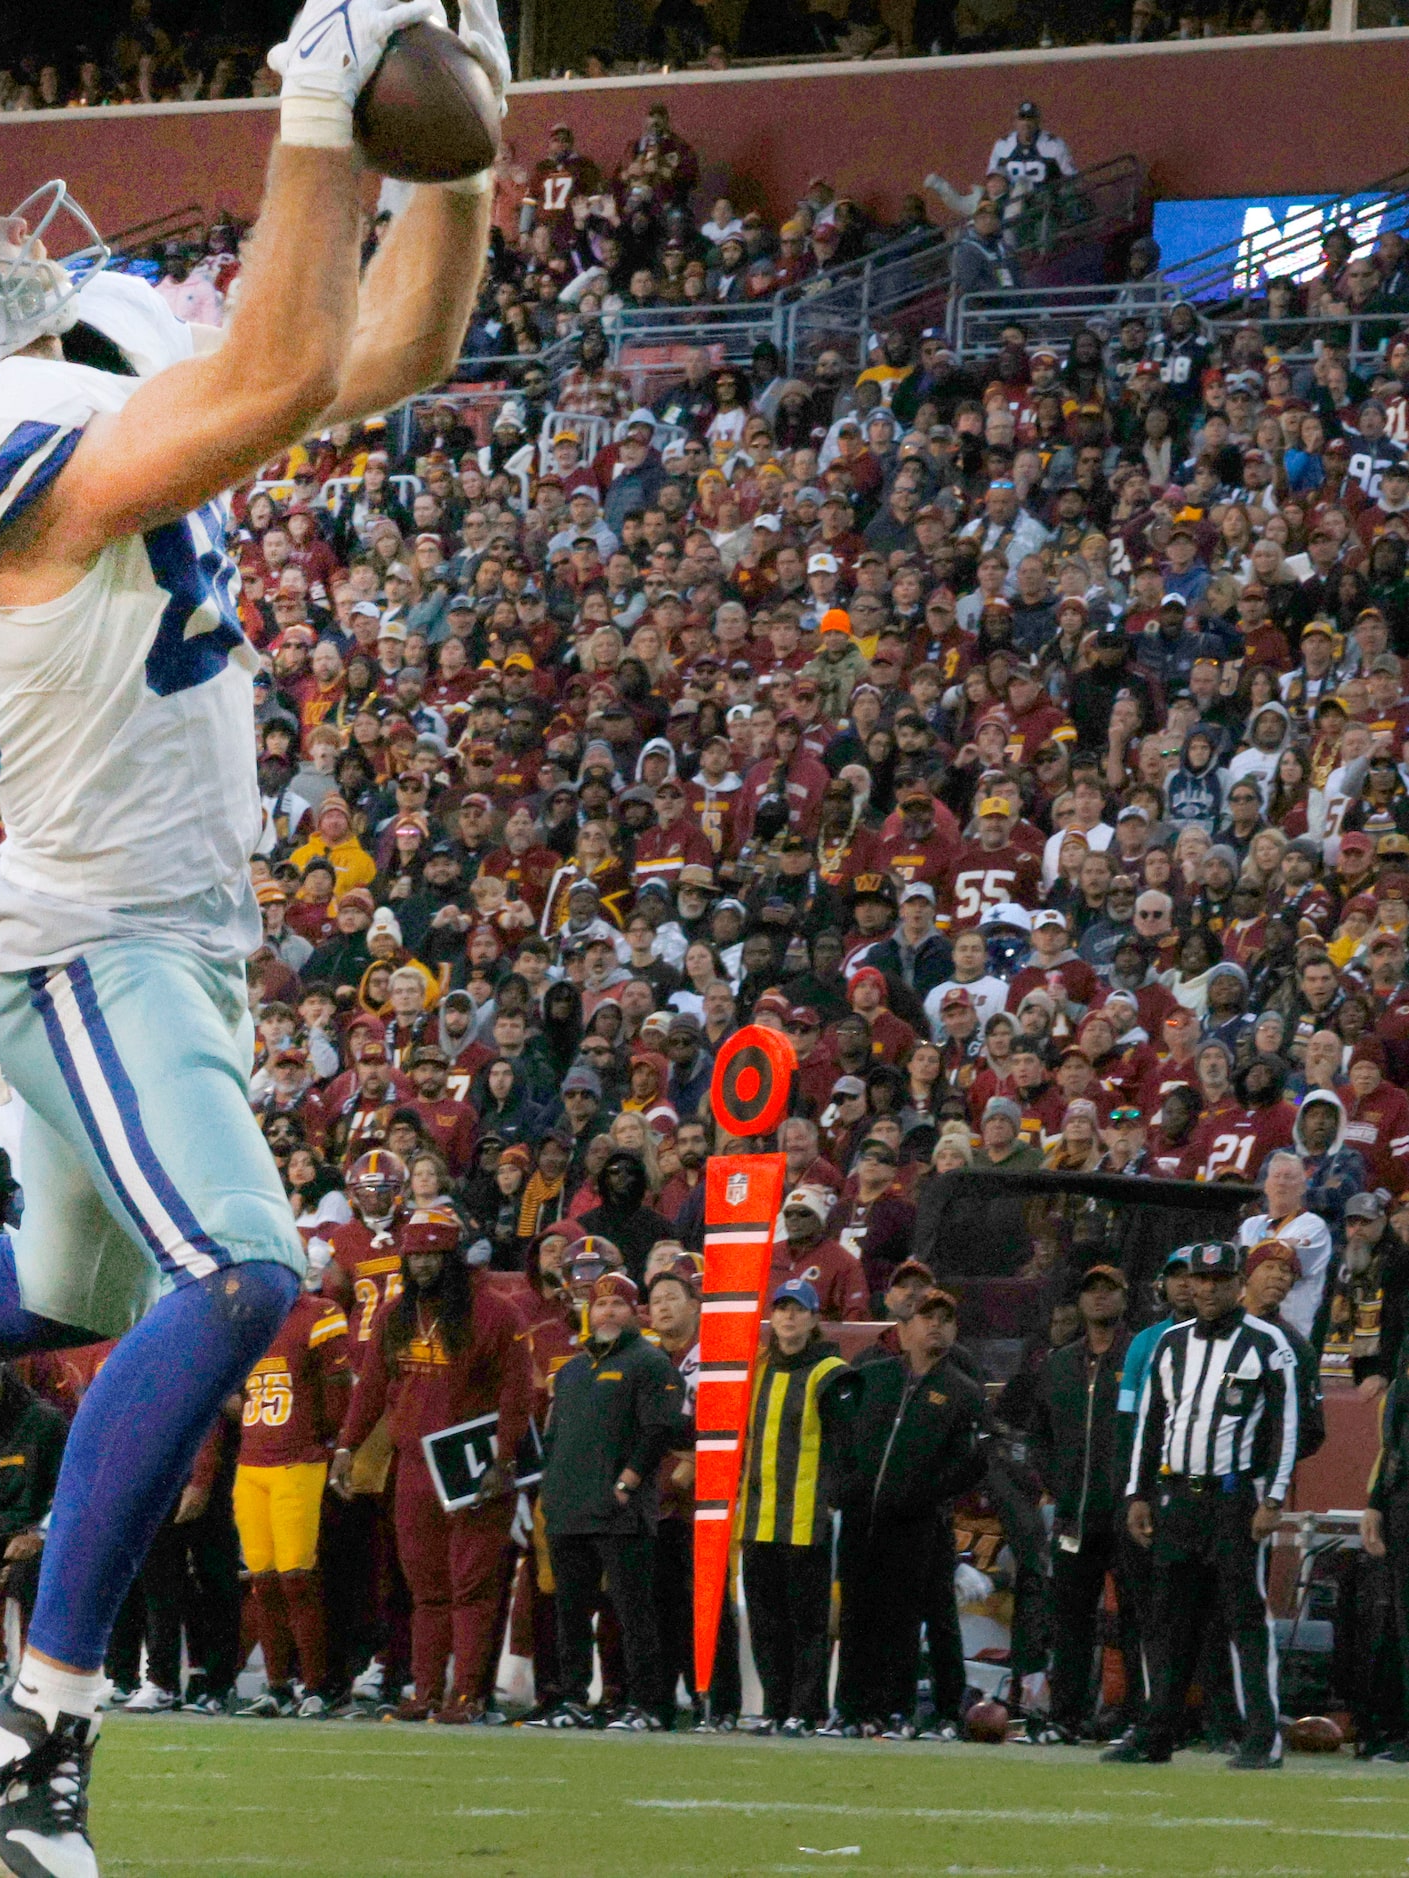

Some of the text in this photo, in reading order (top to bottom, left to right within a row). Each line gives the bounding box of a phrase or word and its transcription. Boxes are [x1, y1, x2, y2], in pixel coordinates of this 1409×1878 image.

[543, 177, 573, 210] 17
[956, 870, 1017, 919] 55
[1205, 1133, 1257, 1181] 21
